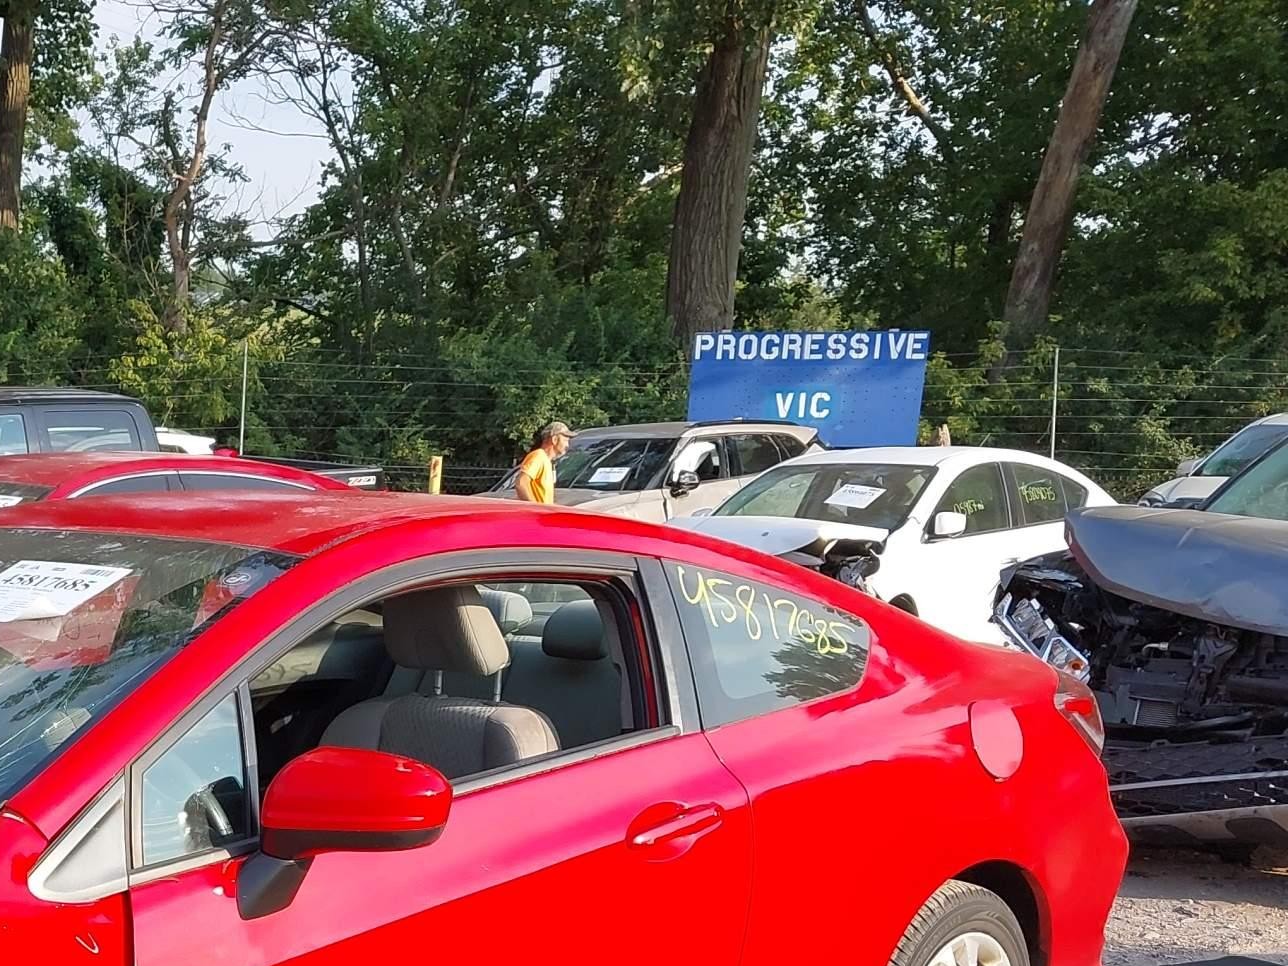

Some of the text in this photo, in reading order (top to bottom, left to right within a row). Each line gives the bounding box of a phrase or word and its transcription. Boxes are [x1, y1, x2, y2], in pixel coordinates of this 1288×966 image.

[694, 332, 929, 361] PROGRESSIVE
[775, 391, 832, 419] VIC
[2, 574, 98, 592] 45817685
[676, 565, 856, 655] 45817685
